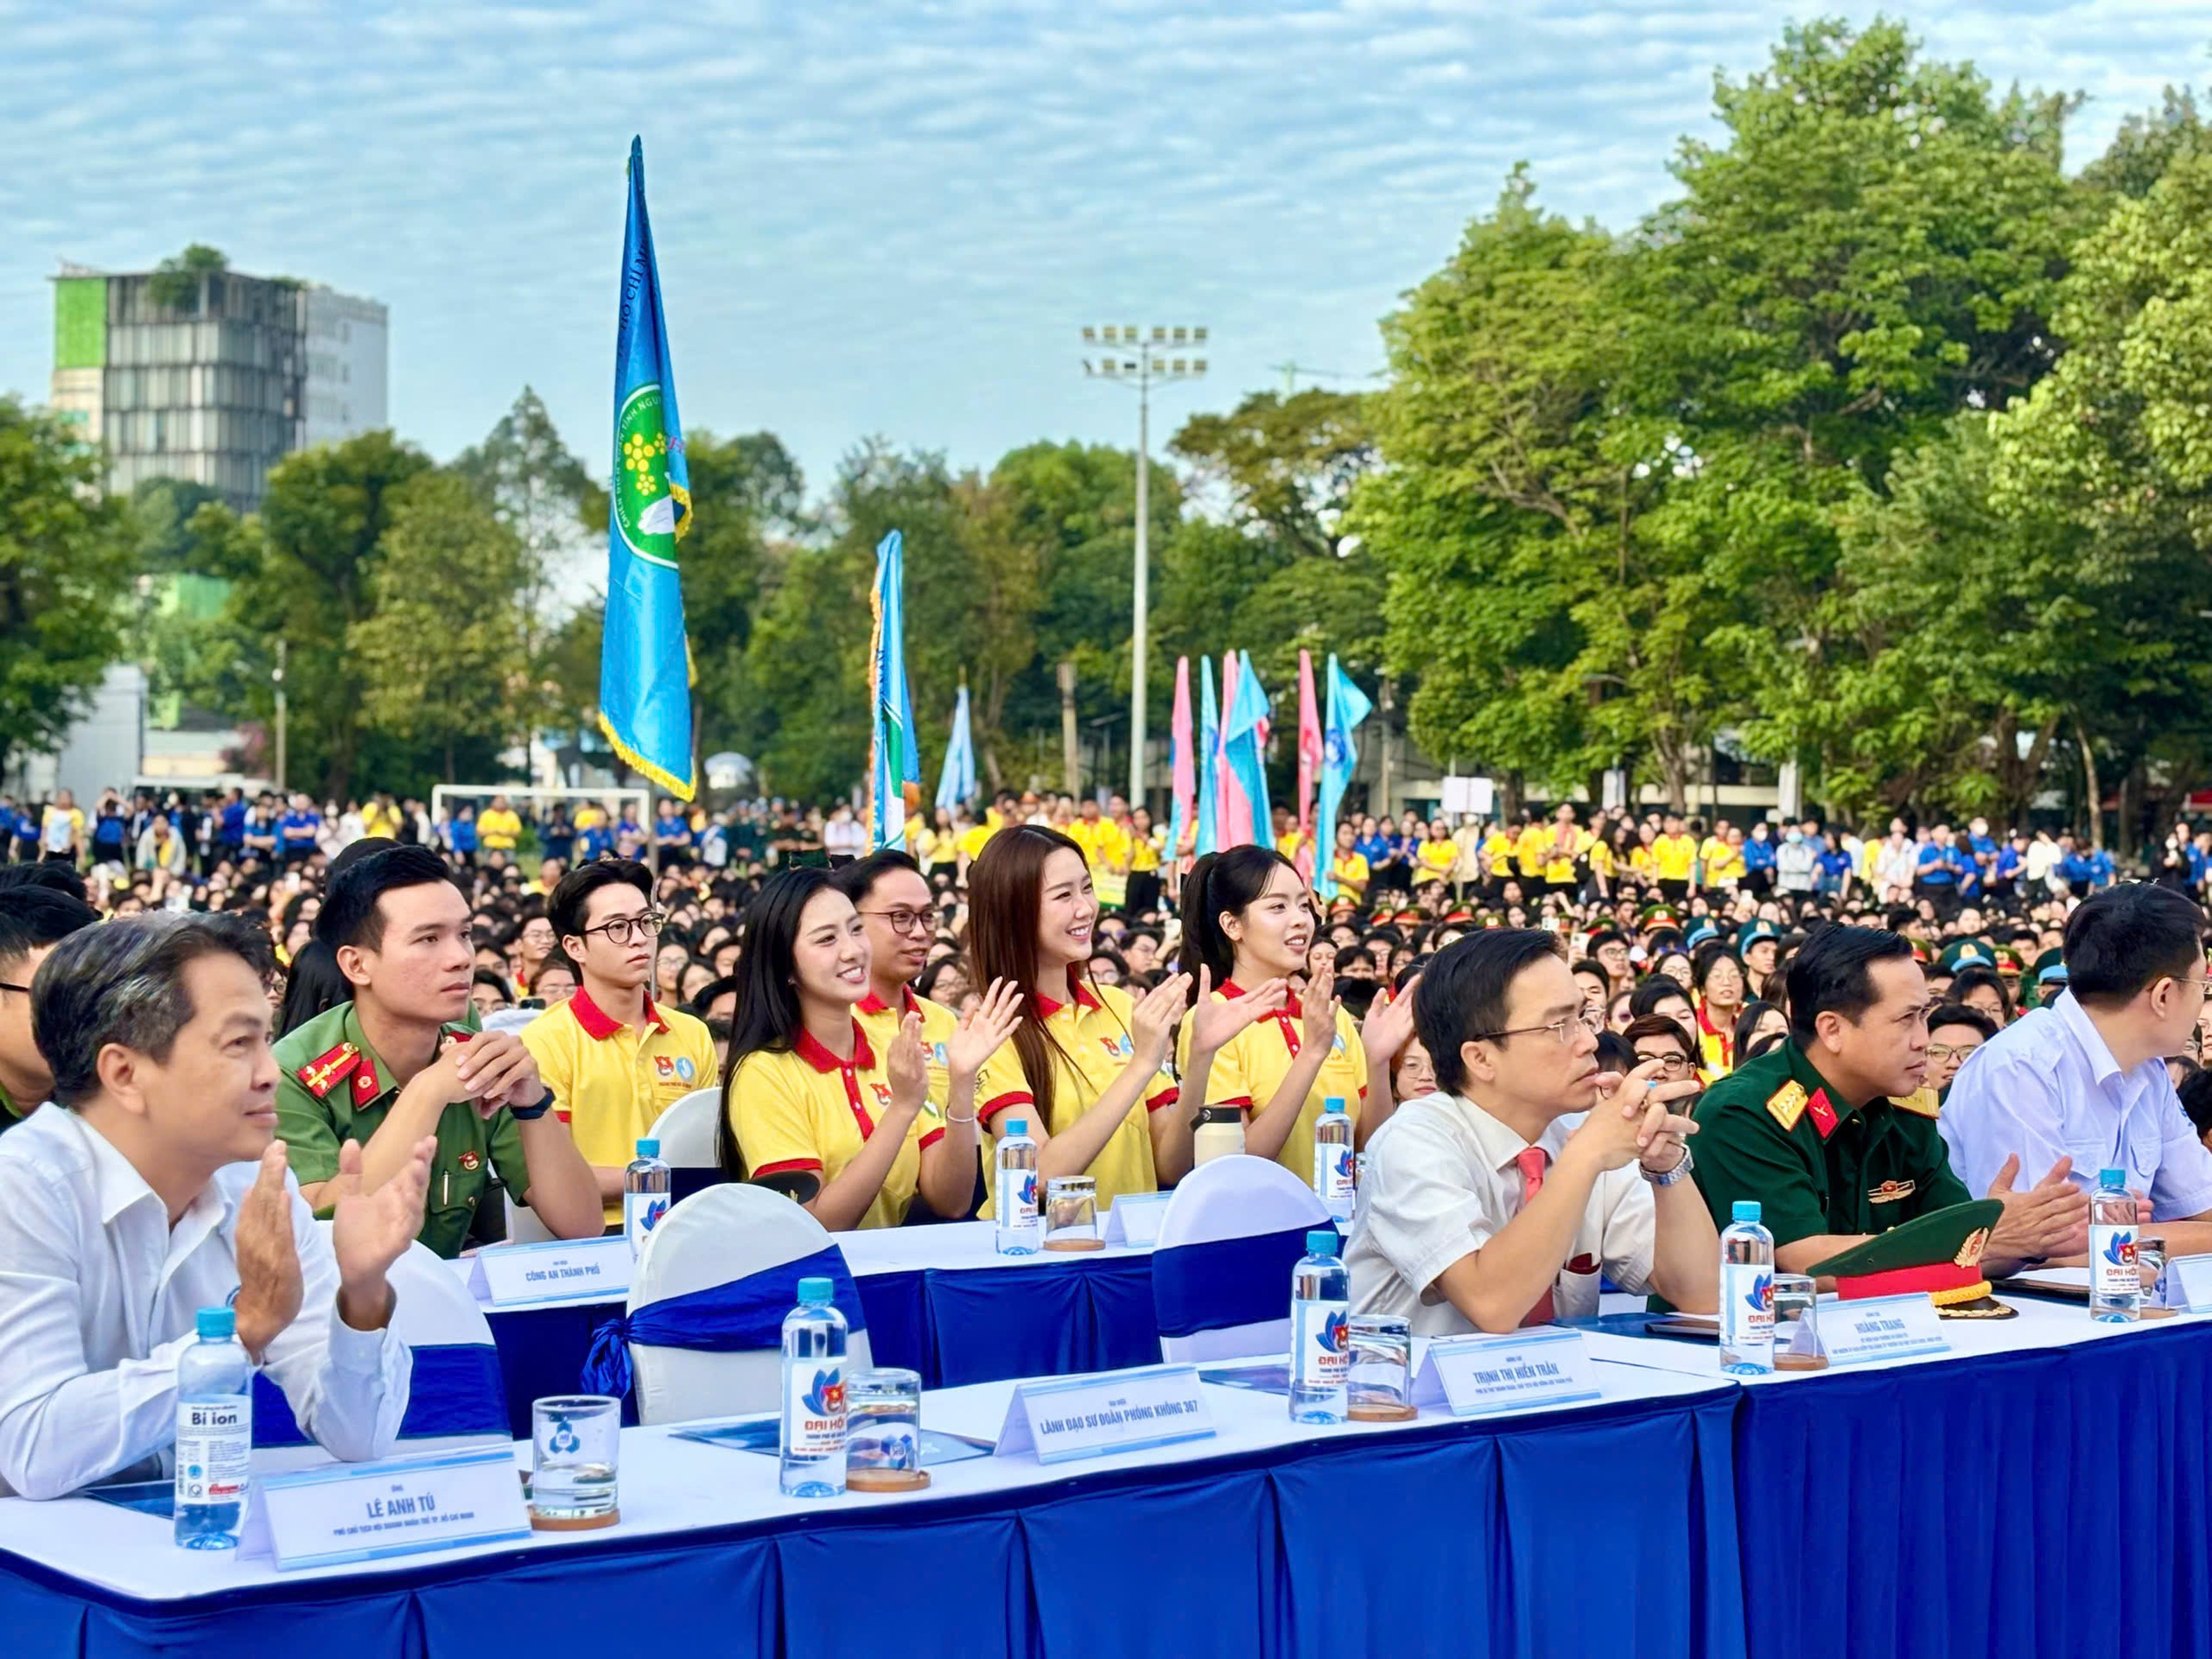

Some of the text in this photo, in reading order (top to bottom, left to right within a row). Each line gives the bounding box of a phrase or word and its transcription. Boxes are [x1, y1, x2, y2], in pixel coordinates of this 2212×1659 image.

[525, 1262, 601, 1281] CÔNG AN THÀNH PHỐ
[1472, 1370, 1501, 1386] TRỊNH
[1499, 1368, 1516, 1382] THỊ
[192, 1412, 238, 1426] Bi ion
[1065, 1415, 1084, 1433] ĐẠO
[1085, 1413, 1098, 1427] SƯ
[1098, 1408, 1123, 1426] ĐOÀN
[1123, 1404, 1154, 1421] PHÒNG
[1154, 1401, 1183, 1417] KHÔNG
[1183, 1400, 1198, 1413] 367
[366, 1491, 435, 1518] LÊ ANH TÚ
